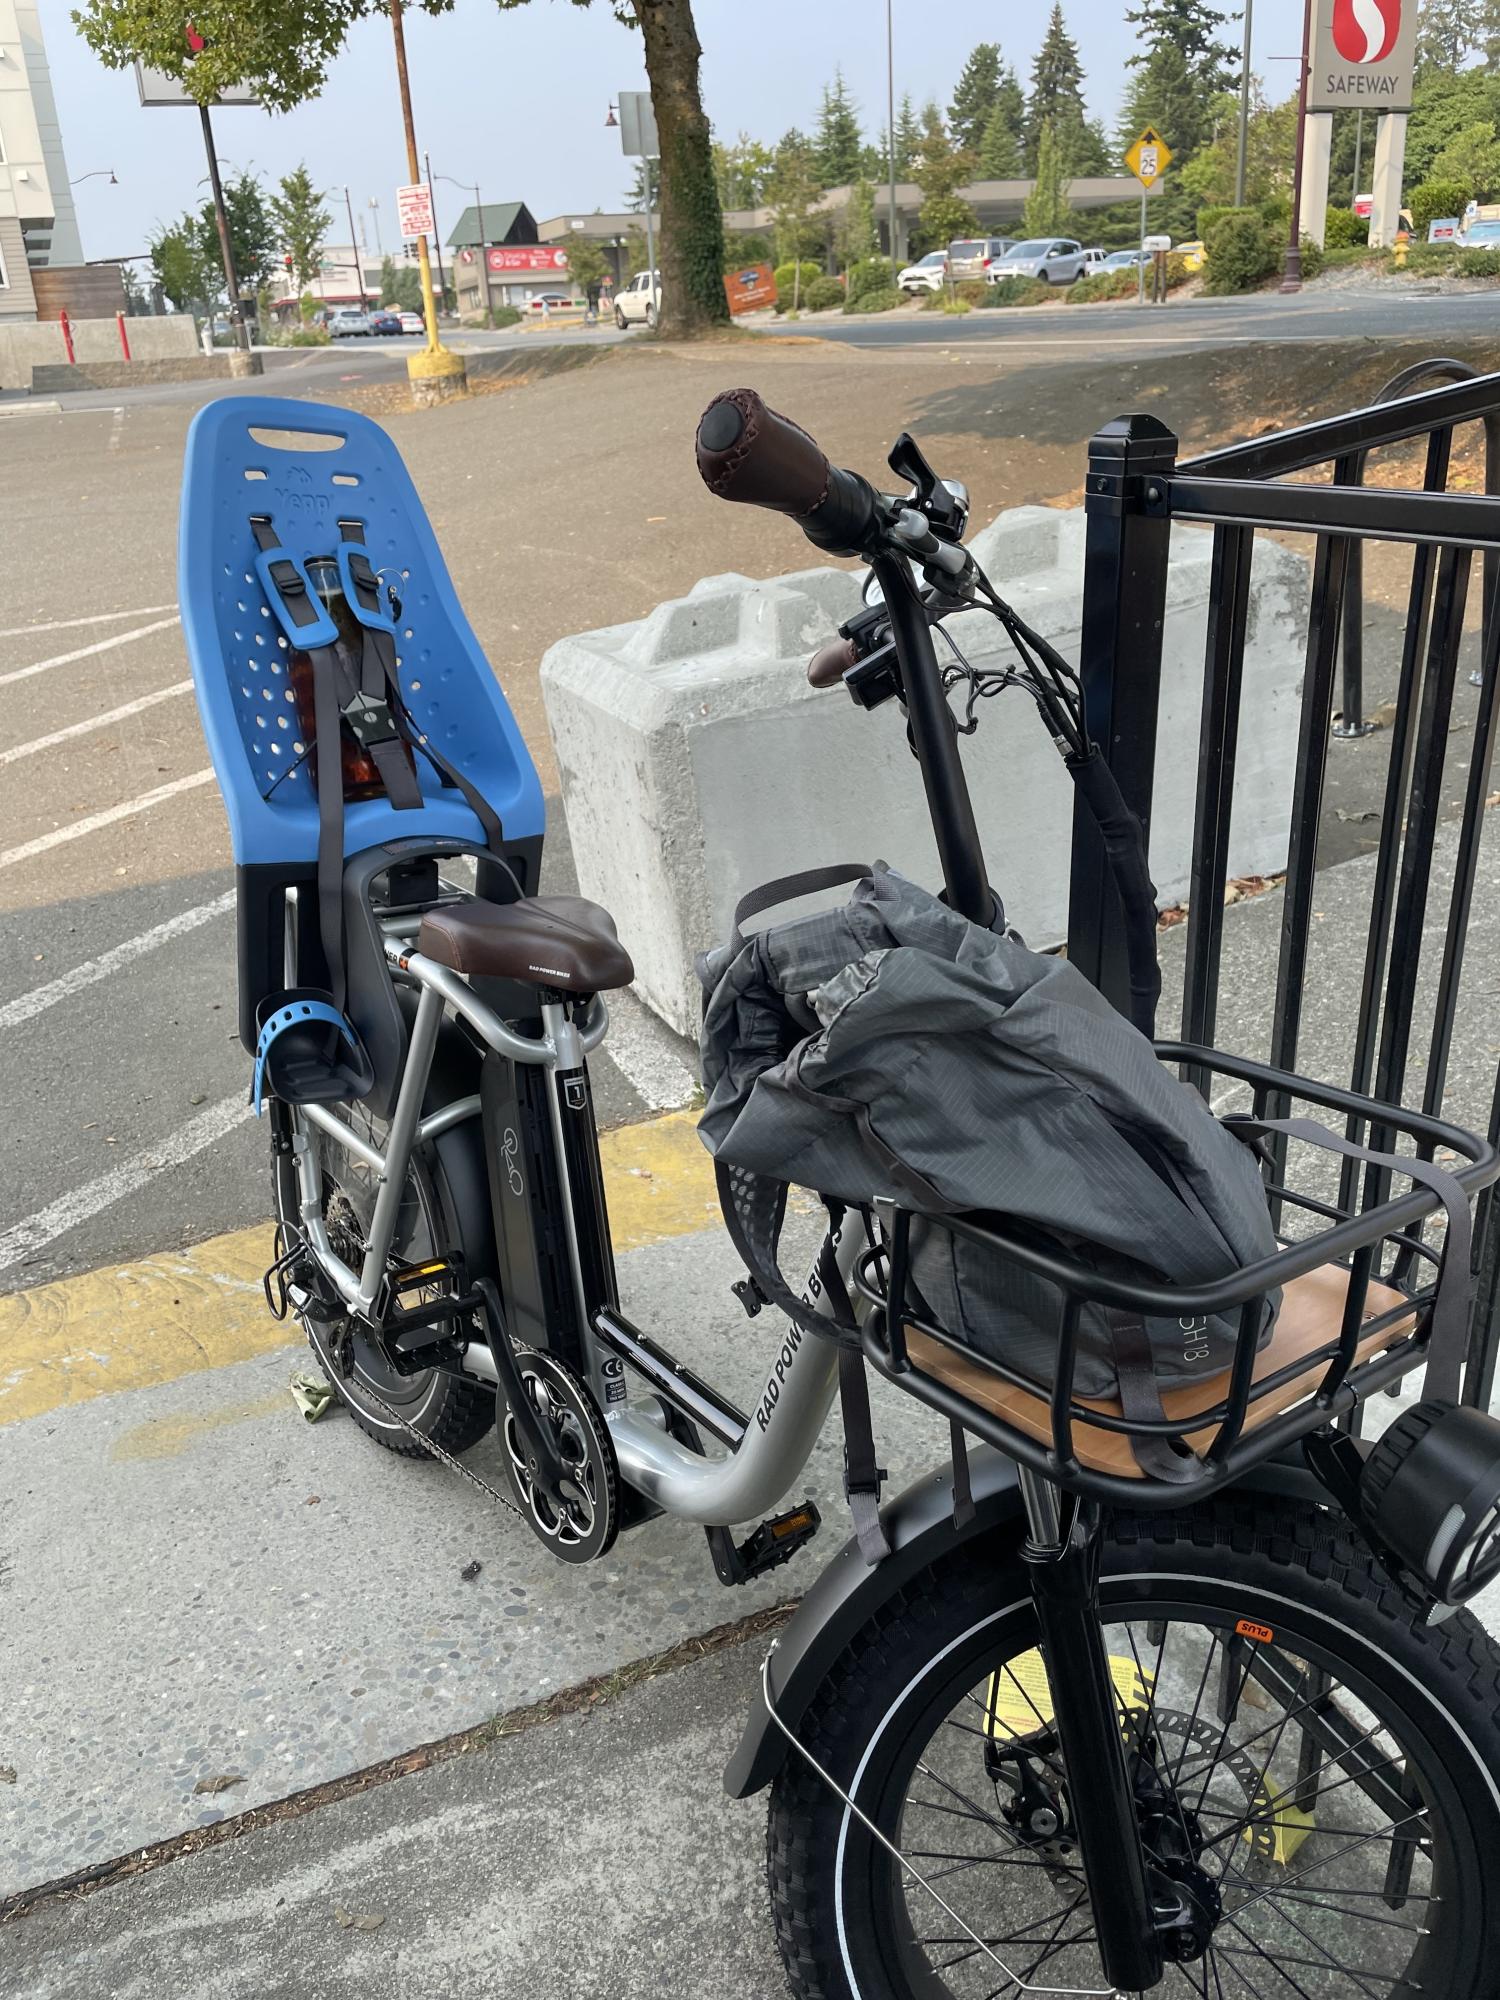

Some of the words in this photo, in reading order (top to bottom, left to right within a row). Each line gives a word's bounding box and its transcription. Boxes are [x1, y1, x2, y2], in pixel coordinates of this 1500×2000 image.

[1326, 74, 1399, 95] SAFEWAY
[1141, 158, 1156, 175] 25
[274, 487, 330, 515] Yepp
[756, 1378, 780, 1433] RAD
[1241, 1623, 1269, 1638] PLUS
